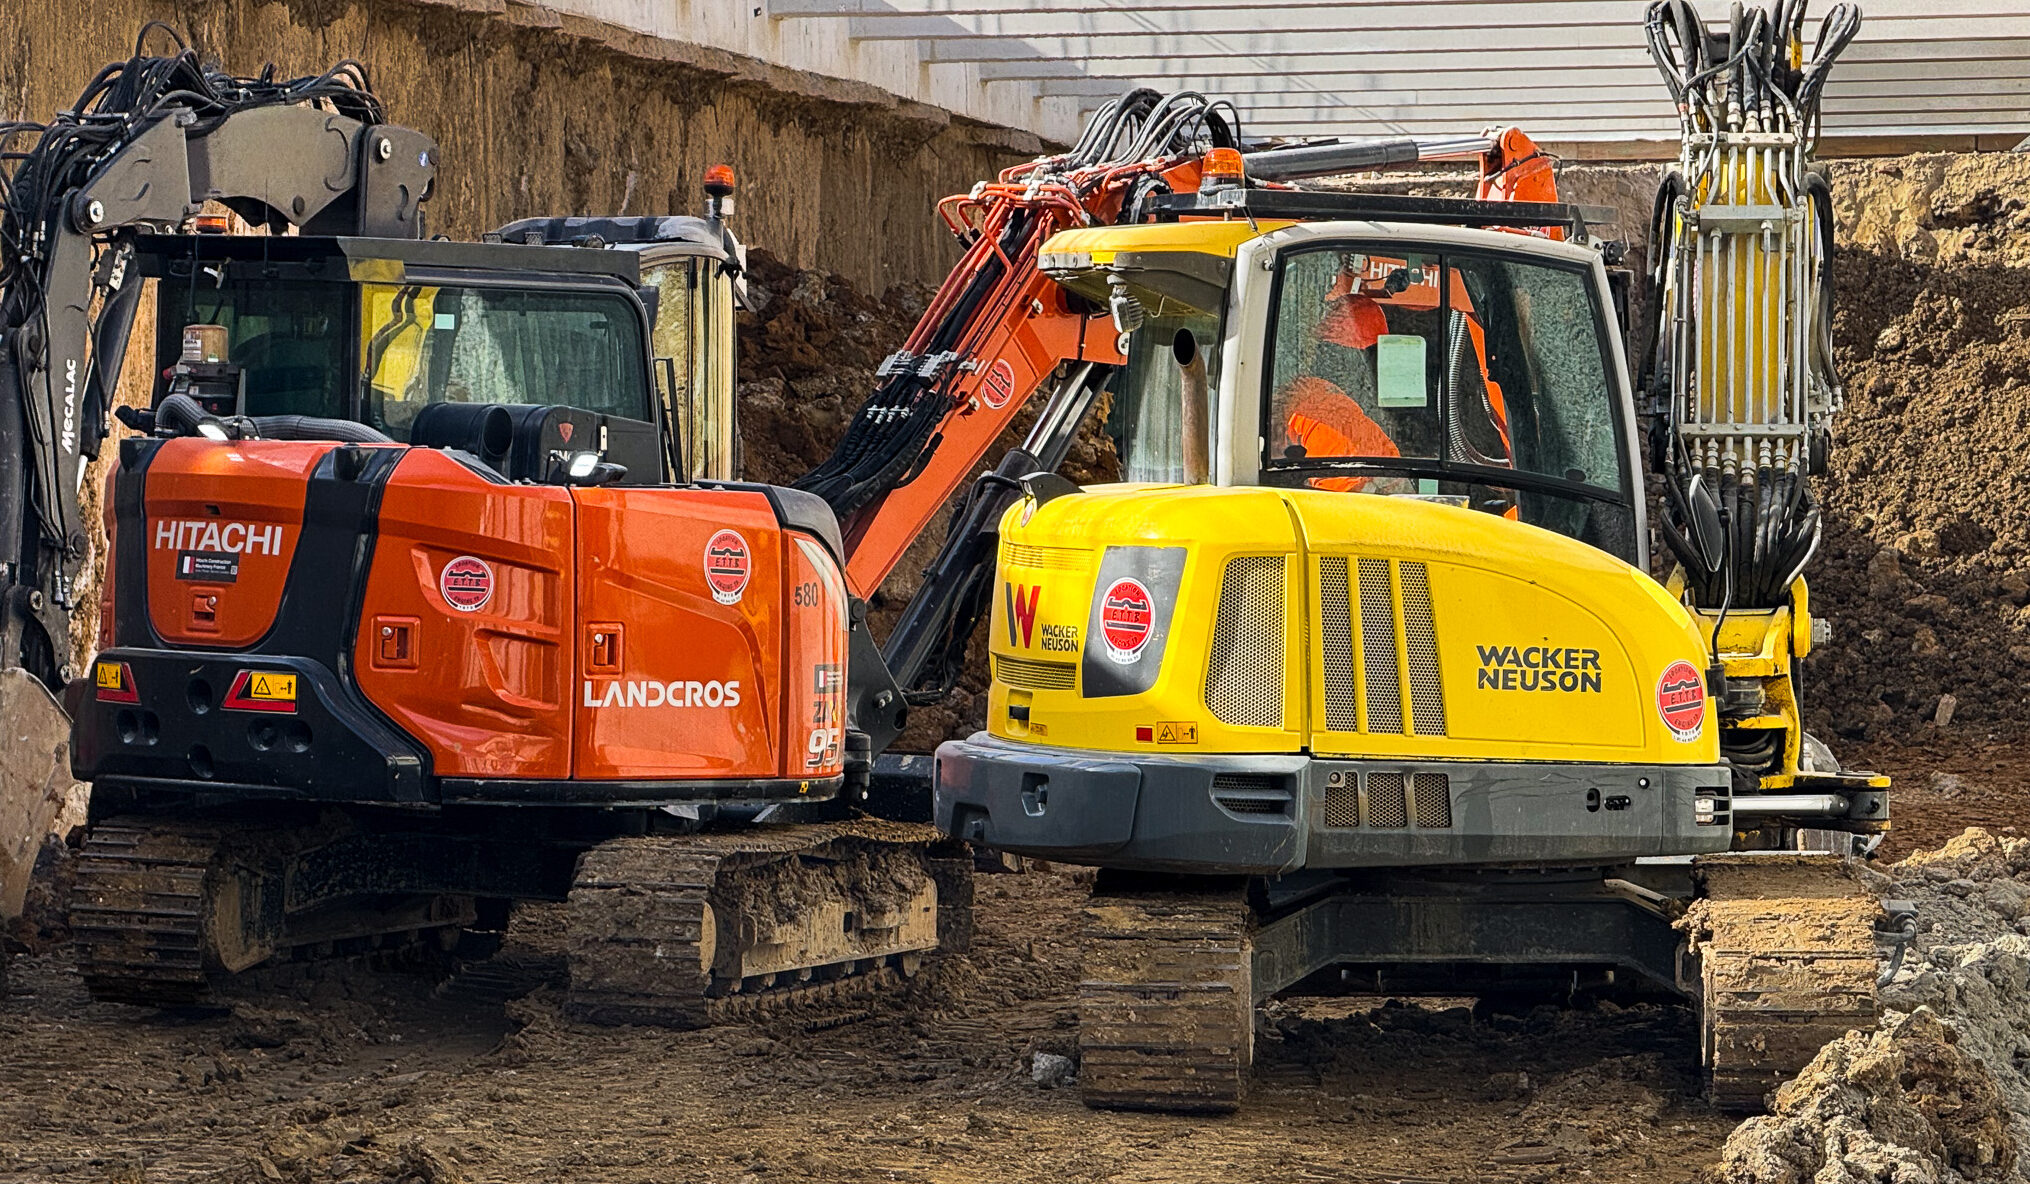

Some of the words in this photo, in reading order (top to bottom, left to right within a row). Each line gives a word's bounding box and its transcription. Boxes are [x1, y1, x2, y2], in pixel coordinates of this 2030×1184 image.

[155, 520, 283, 556] HITACHI
[794, 582, 819, 607] 580
[1041, 623, 1078, 638] WACKER
[1041, 637, 1079, 653] NEUSON
[1476, 645, 1602, 670] WACKER
[1477, 667, 1602, 693] NEUSON
[584, 680, 740, 708] LANDCROS
